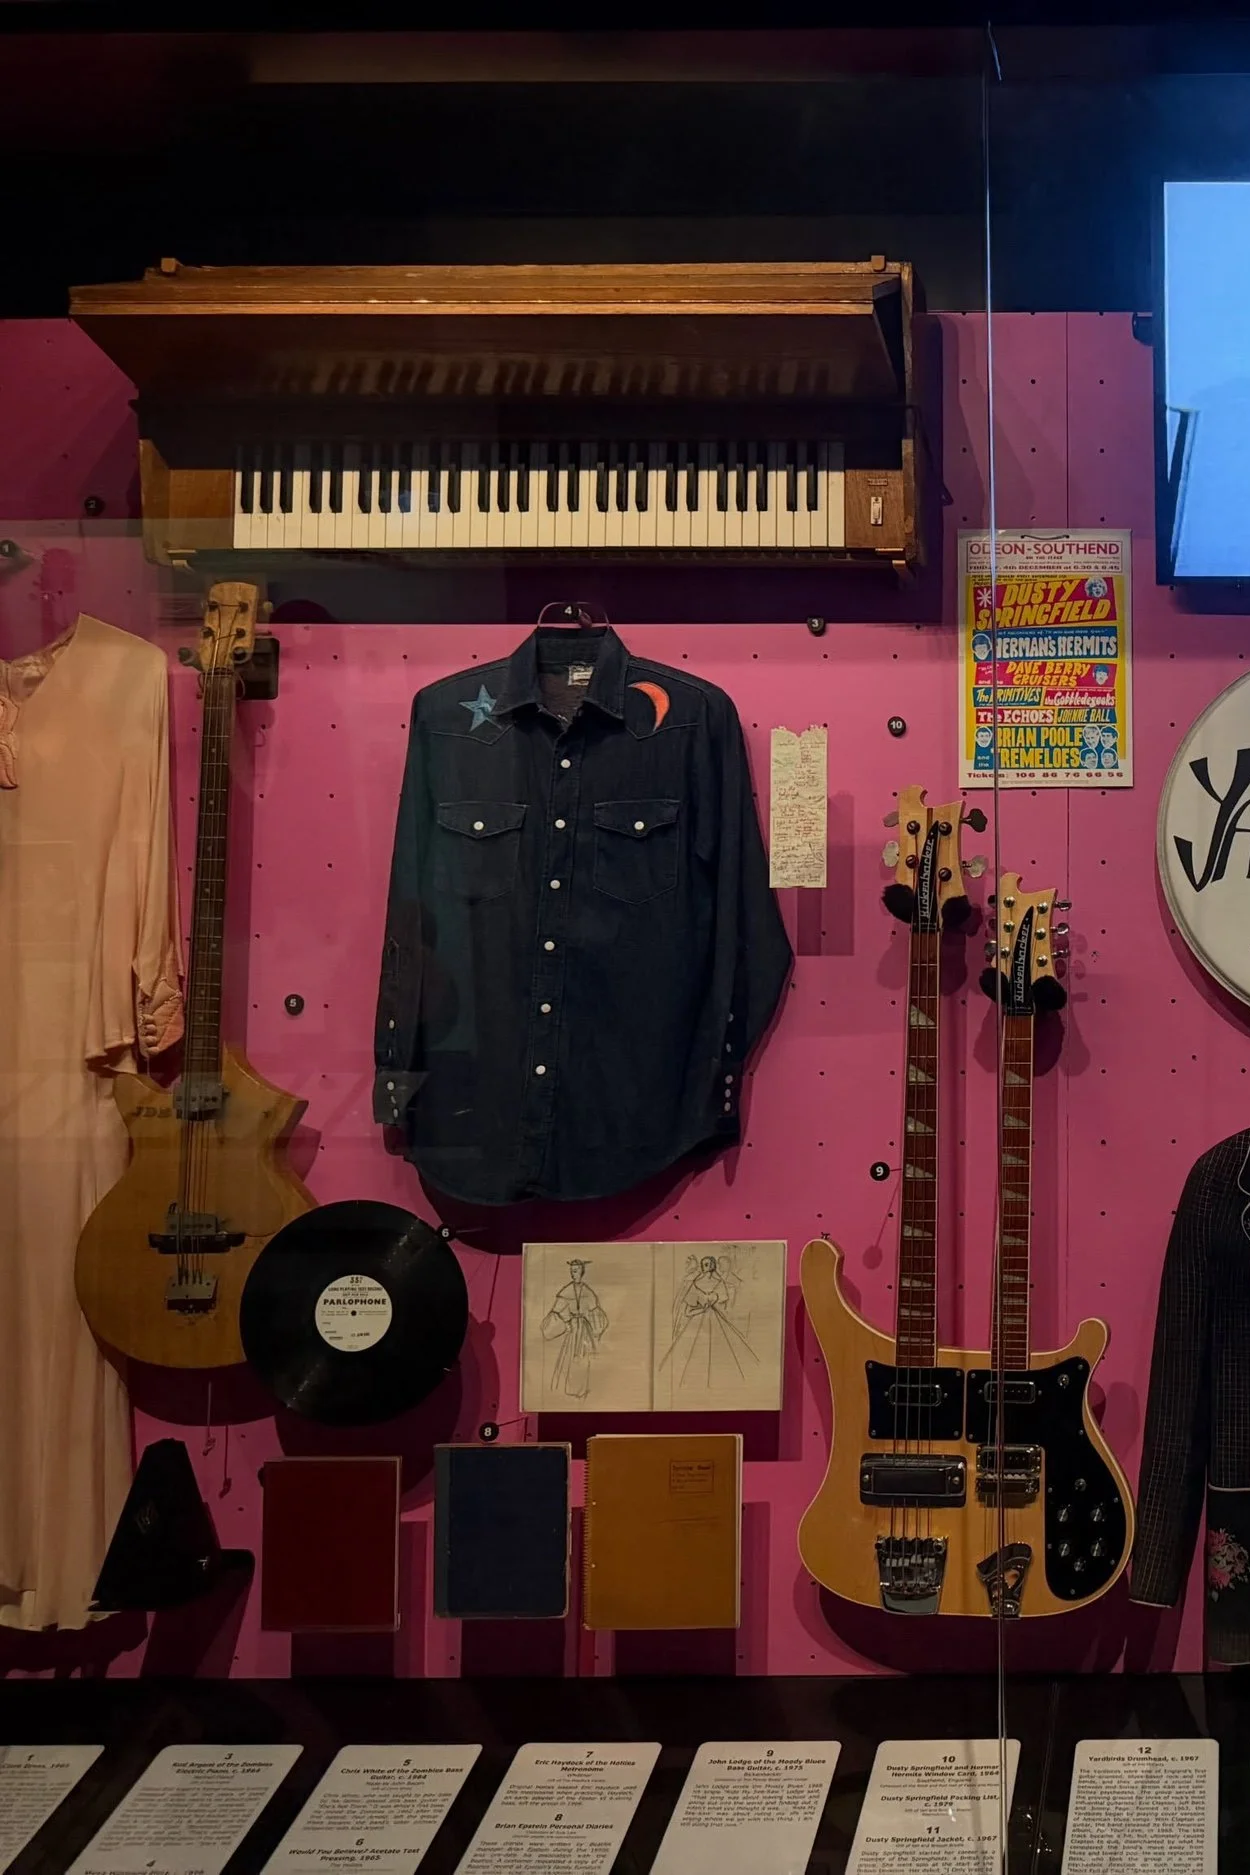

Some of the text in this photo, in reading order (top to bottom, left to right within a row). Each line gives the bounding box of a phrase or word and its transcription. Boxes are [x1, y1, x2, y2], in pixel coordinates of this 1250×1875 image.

[1002, 579, 1081, 606] DUSTY
[564, 605, 572, 614] 4
[976, 599, 1111, 630] SPRINGFIELD
[811, 618, 819, 627] 3
[1058, 636, 1118, 657] HERMITS
[1006, 661, 1091, 678] DAVE BERRY
[1012, 674, 1078, 688] CRUISERS
[977, 688, 988, 703] The
[1003, 709, 1054, 723] ECHOES
[890, 720, 903, 730] 10
[1040, 727, 1083, 747] POOLE
[289, 998, 297, 1007] 5
[876, 1166, 884, 1176] 9
[441, 1228, 449, 1238] 6
[324, 1298, 387, 1306] PARLOPHONE
[484, 1426, 492, 1436] 8
[1138, 1746, 1152, 1754] 12
[926, 1826, 940, 1834] 11
